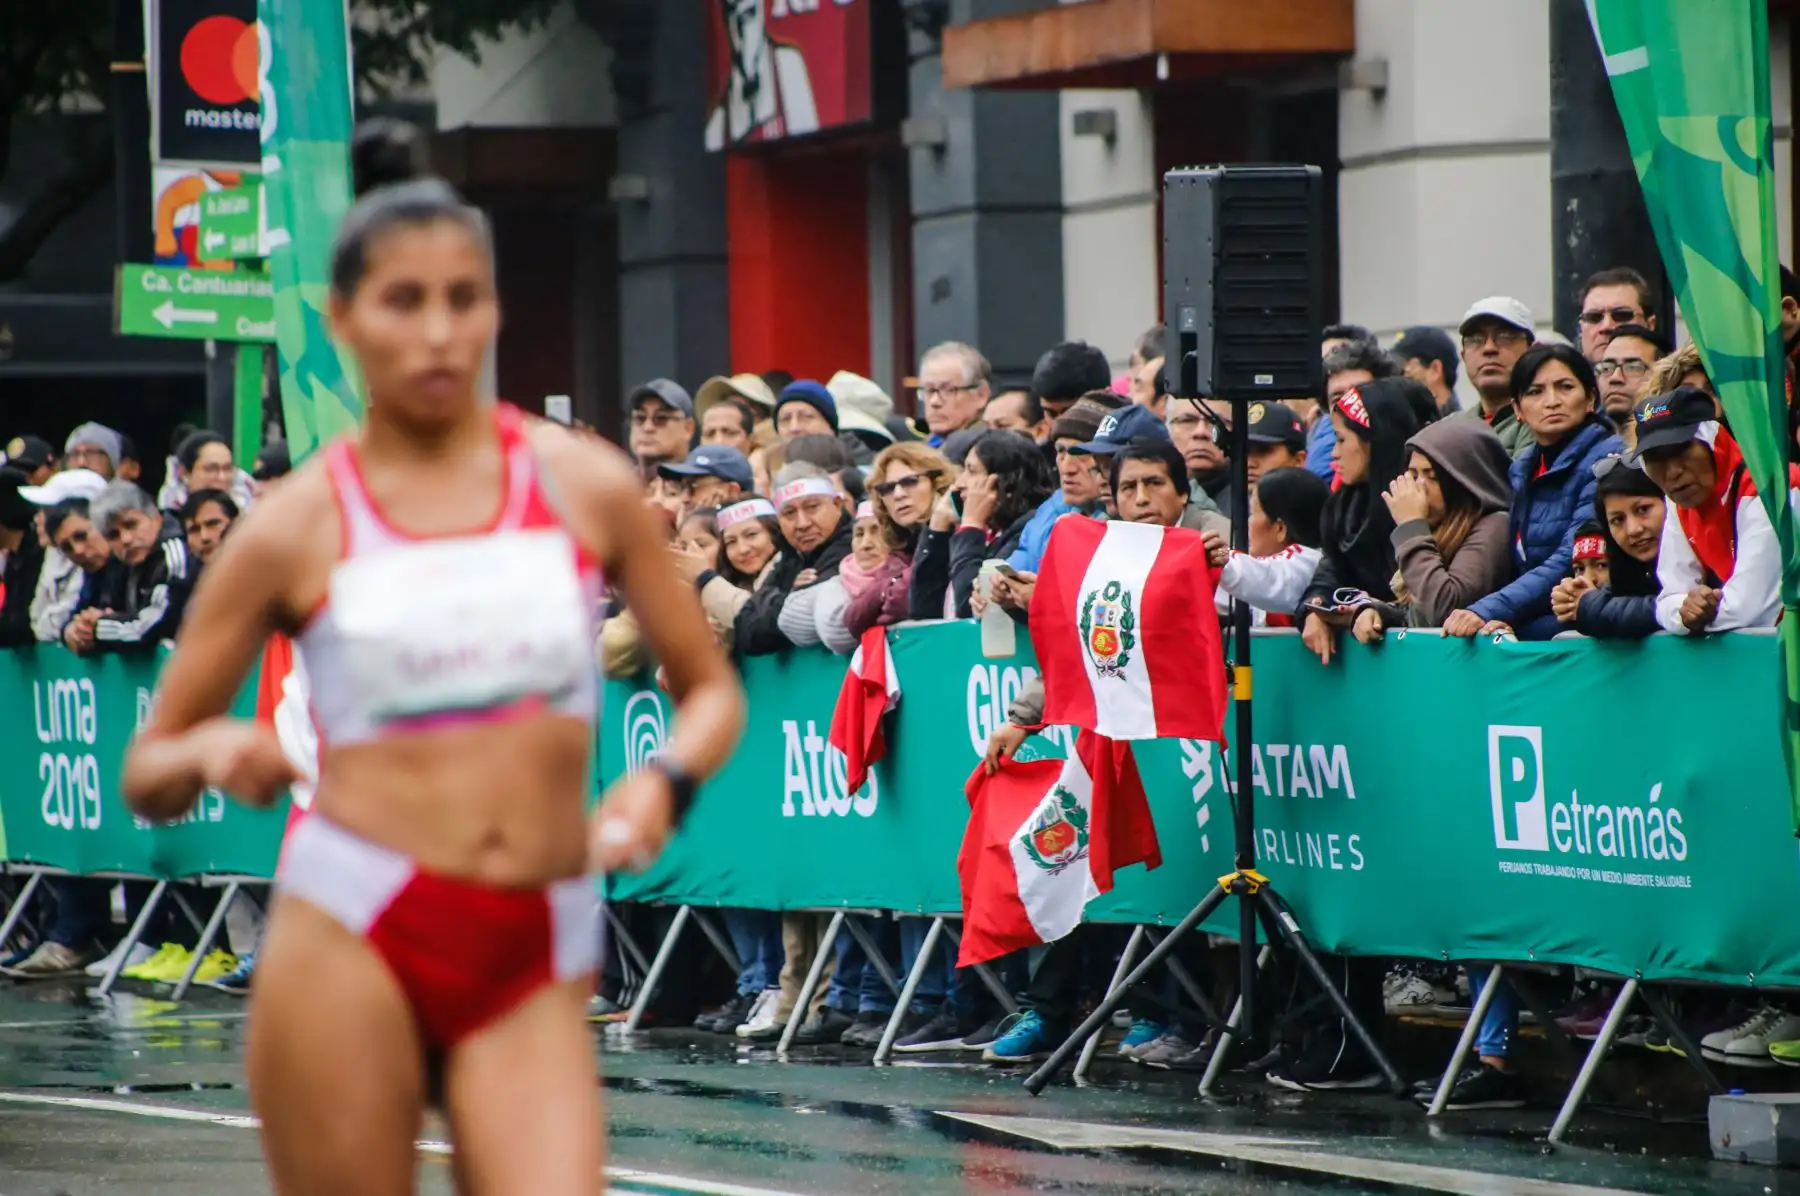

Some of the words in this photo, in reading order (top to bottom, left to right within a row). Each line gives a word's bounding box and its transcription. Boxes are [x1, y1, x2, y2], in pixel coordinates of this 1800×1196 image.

[39, 751, 101, 831] 2019
[1488, 724, 1688, 862] Petramás
[1252, 827, 1365, 871] IRLINES
[1498, 861, 1533, 875] PERUANOS
[1533, 863, 1577, 879] TRABAJANDO
[1576, 867, 1591, 881] POR
[1591, 869, 1601, 881] UN
[1602, 870, 1622, 884] MEDIO
[1623, 872, 1655, 887] AMBIENTE
[1655, 874, 1692, 888] SALUDABLE
